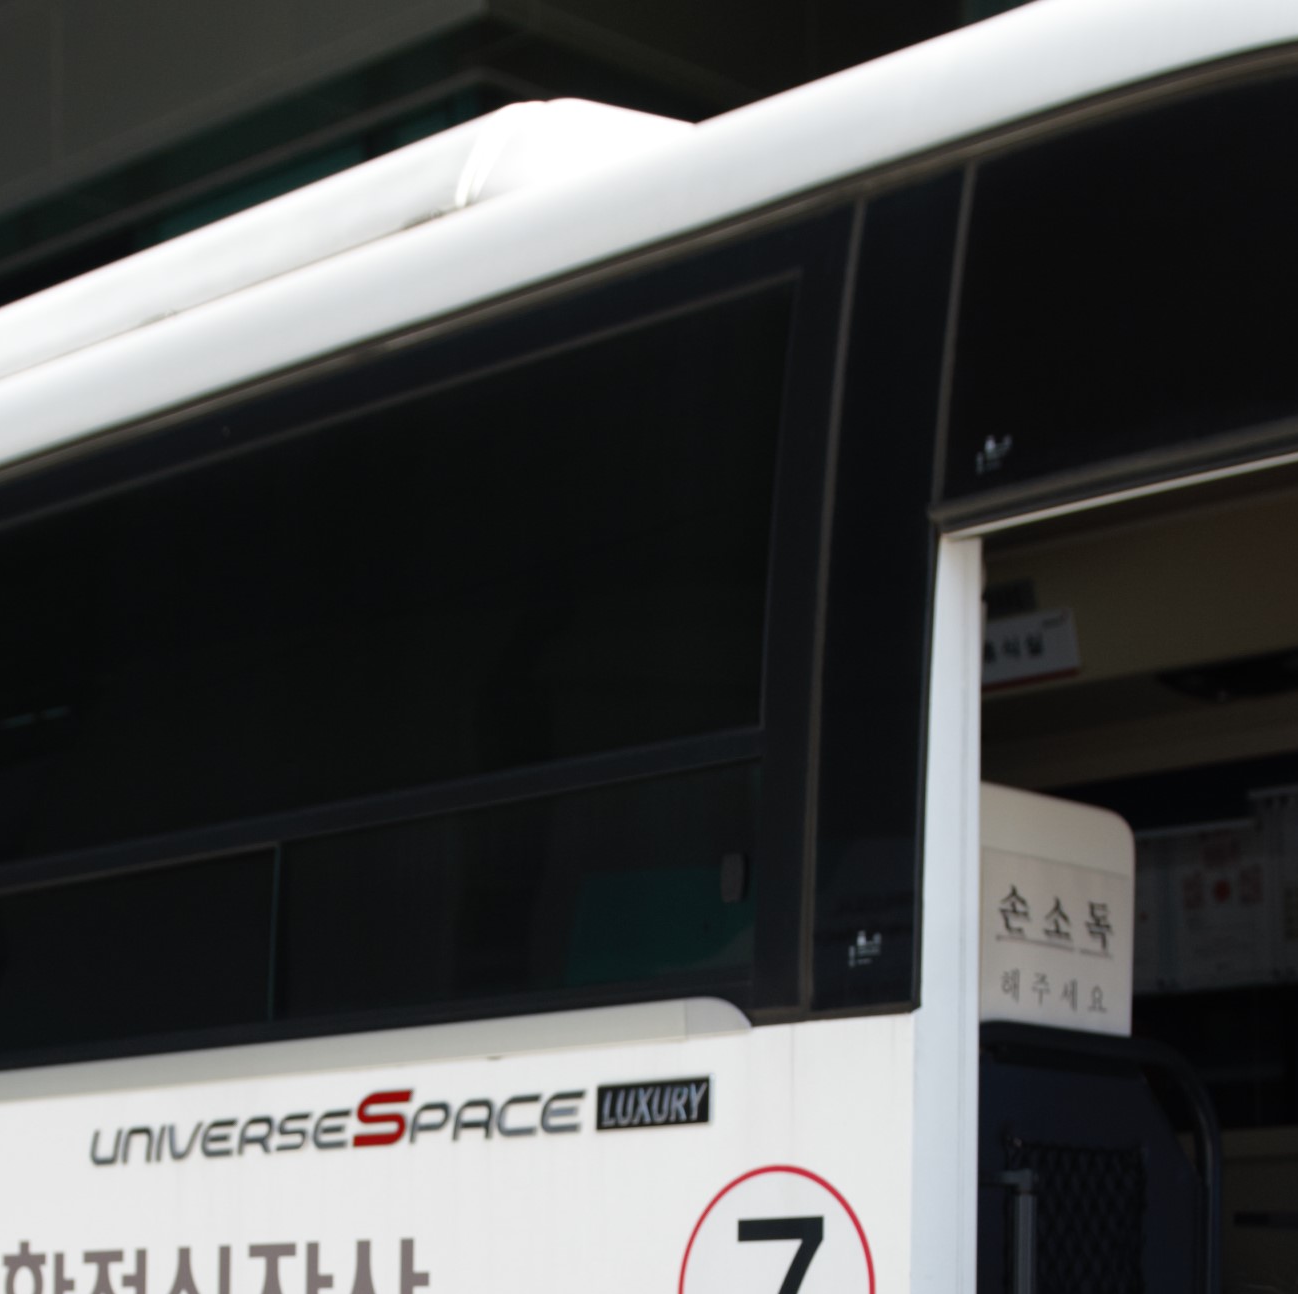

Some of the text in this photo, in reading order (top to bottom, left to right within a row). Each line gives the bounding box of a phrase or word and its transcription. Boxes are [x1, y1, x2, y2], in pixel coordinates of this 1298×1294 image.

[998, 884, 1114, 951] 손소독
[1001, 967, 1108, 1013] 해주세요
[601, 1082, 708, 1128] LUXURY
